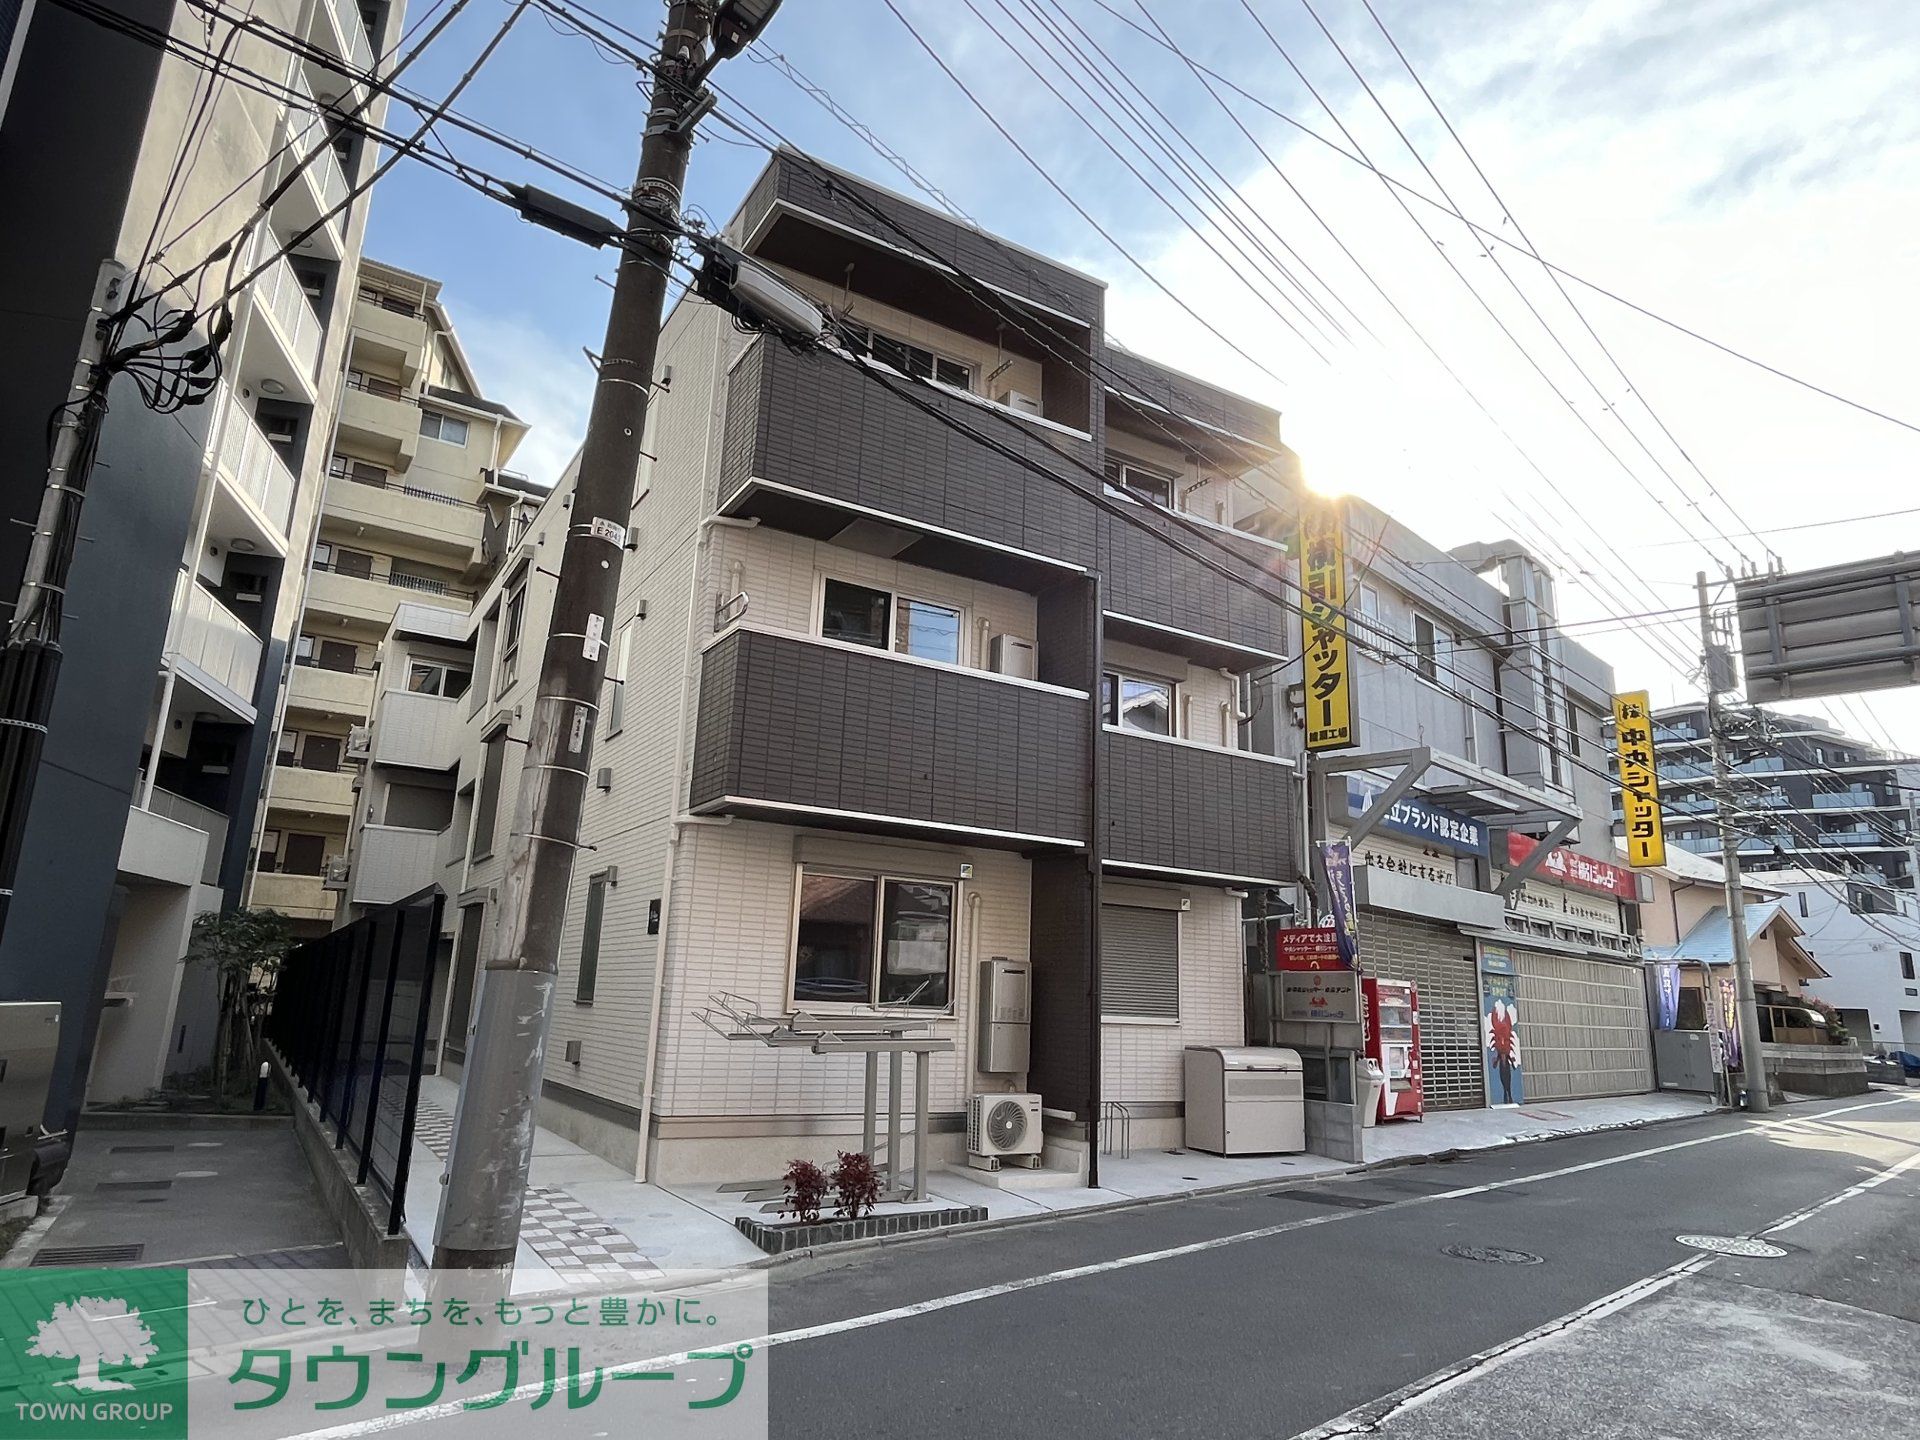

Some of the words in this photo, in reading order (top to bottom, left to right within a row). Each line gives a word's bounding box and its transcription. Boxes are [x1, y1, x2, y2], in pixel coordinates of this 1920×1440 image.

[1384, 803, 1479, 846] 立ブランド認定企業
